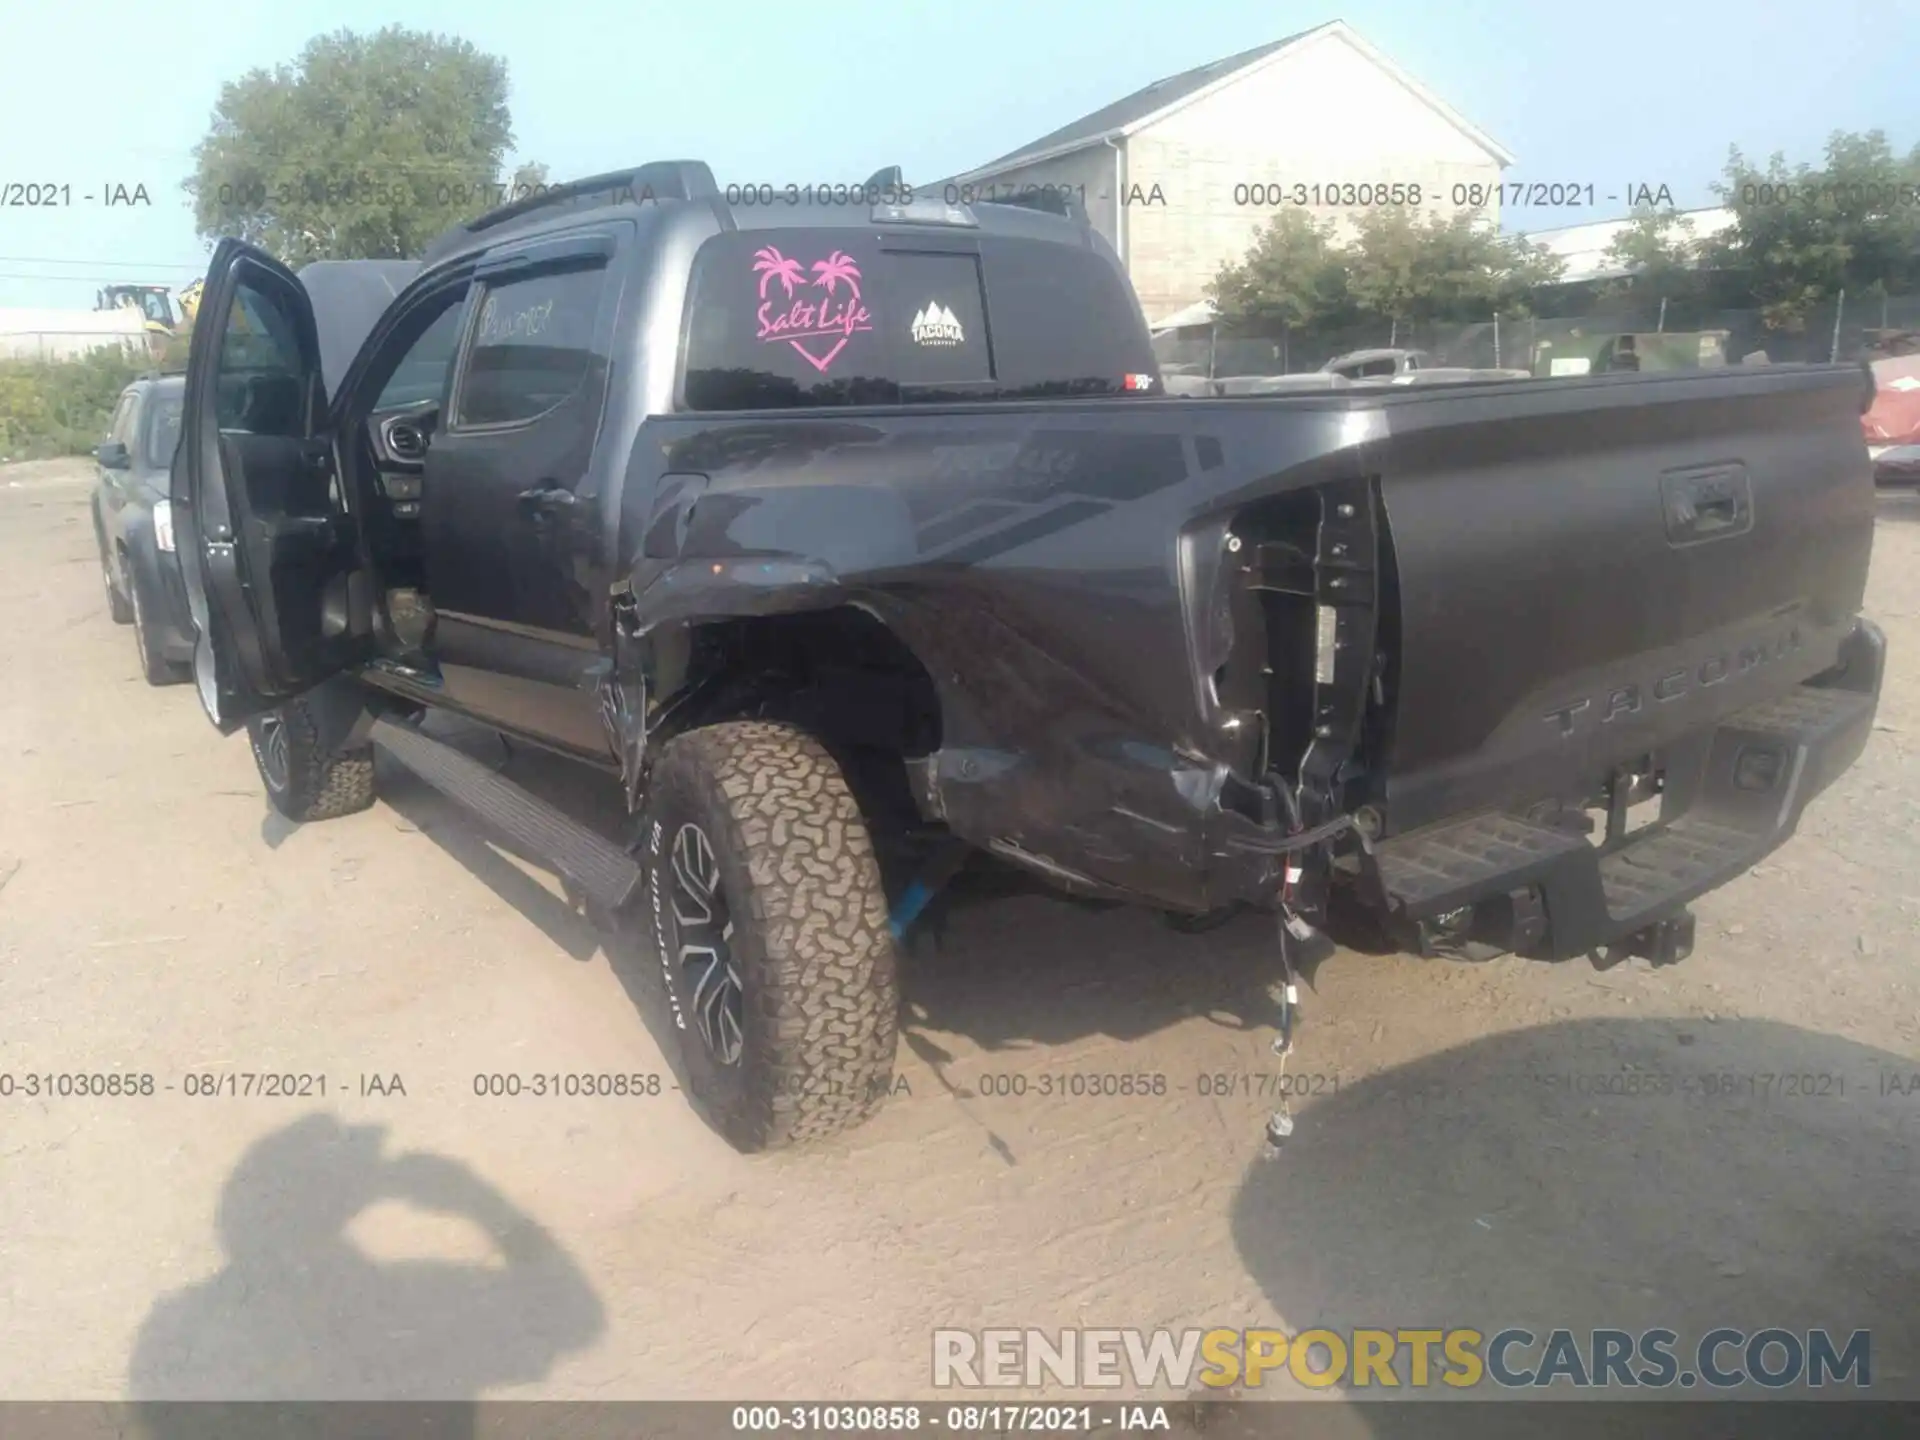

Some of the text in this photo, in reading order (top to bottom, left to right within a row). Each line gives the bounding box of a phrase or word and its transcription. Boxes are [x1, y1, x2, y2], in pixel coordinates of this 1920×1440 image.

[757, 298, 871, 337] Salt Life
[912, 324, 965, 342] TACOMA
[1542, 628, 1800, 739] TACOMA
